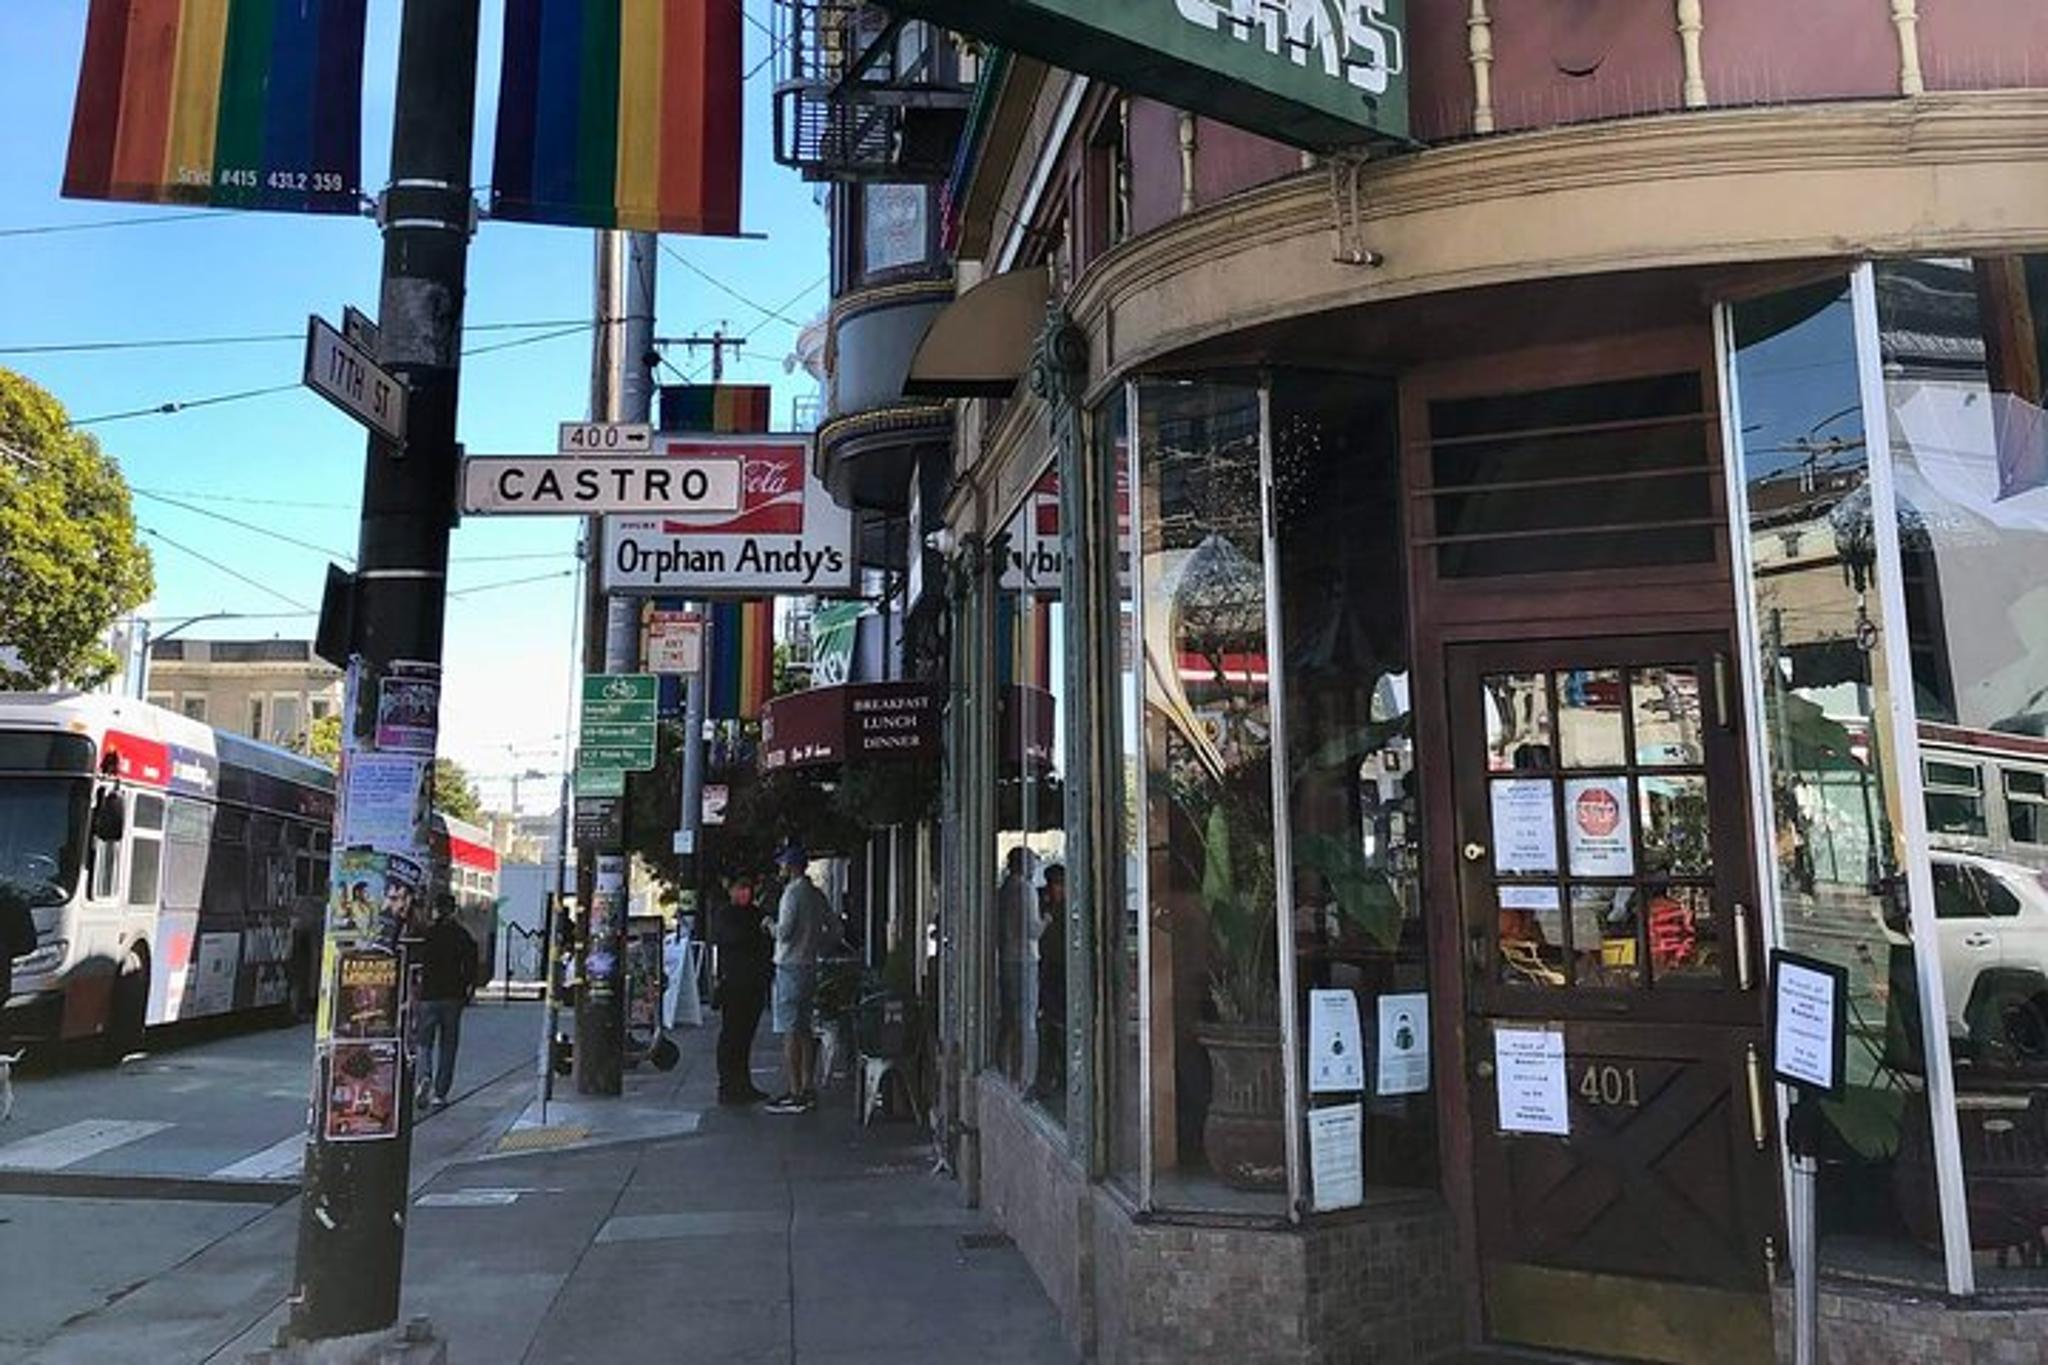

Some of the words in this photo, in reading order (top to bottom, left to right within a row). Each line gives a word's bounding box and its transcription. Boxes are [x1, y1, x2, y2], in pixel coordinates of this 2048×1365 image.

[329, 344, 365, 401] 17TH
[374, 378, 391, 419] ST
[570, 426, 619, 448] 400
[498, 468, 709, 501] CASTRO
[616, 538, 726, 584] Orphan
[734, 538, 844, 584] Andy's
[853, 696, 929, 712] BREAKFAST
[863, 715, 918, 730] LUNCH
[863, 735, 921, 750] DINNER
[1579, 1064, 1640, 1108] 401
